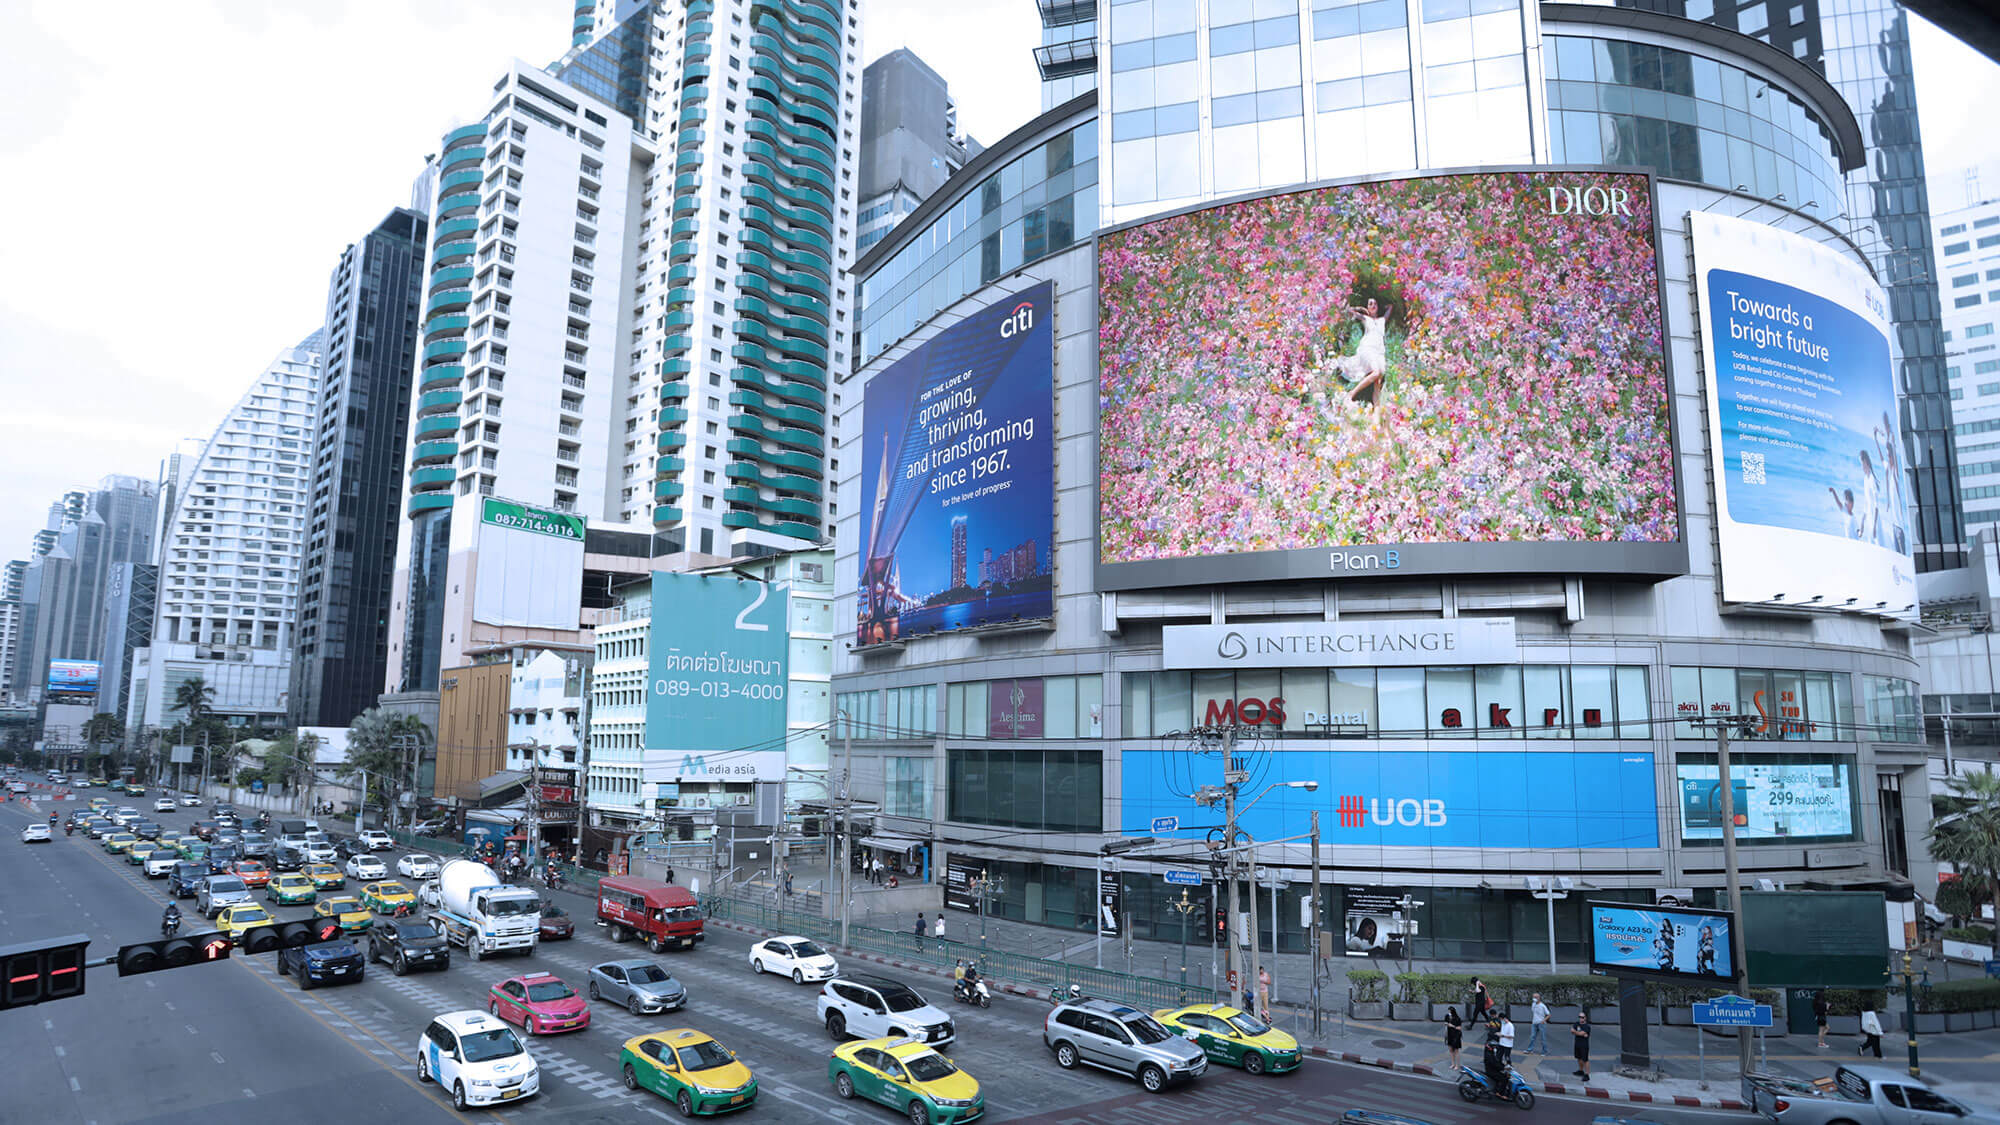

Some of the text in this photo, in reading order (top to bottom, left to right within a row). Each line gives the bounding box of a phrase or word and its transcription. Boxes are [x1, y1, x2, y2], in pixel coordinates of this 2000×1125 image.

[1547, 186, 1632, 216] DIOR
[1000, 304, 1033, 338] citi
[1727, 291, 1813, 330] Towards a
[1730, 318, 1829, 362] bright future
[920, 370, 973, 402] FOR THE LOVE OF
[919, 387, 977, 428] growing,
[928, 409, 987, 445] thriving,
[907, 418, 1034, 479] and transforming
[931, 450, 1011, 494] since 1967.
[942, 497, 951, 507] for
[951, 494, 961, 504] the
[962, 491, 974, 502] love
[975, 488, 981, 498] of
[495, 513, 574, 537] 087-714-6116
[1256, 632, 1455, 654] INTERCHANGE
[667, 648, 782, 677] ติดต่อโฆษณา
[655, 680, 784, 700] 089-013-4000
[1205, 697, 1287, 727] MOS
[1304, 711, 1367, 726] Dental
[1441, 703, 1601, 729] akru
[1677, 701, 1698, 711] akru
[1711, 702, 1730, 712] akru
[679, 754, 756, 776] Media asia
[1371, 799, 1447, 826] UOB
[1769, 791, 1793, 806] 299
